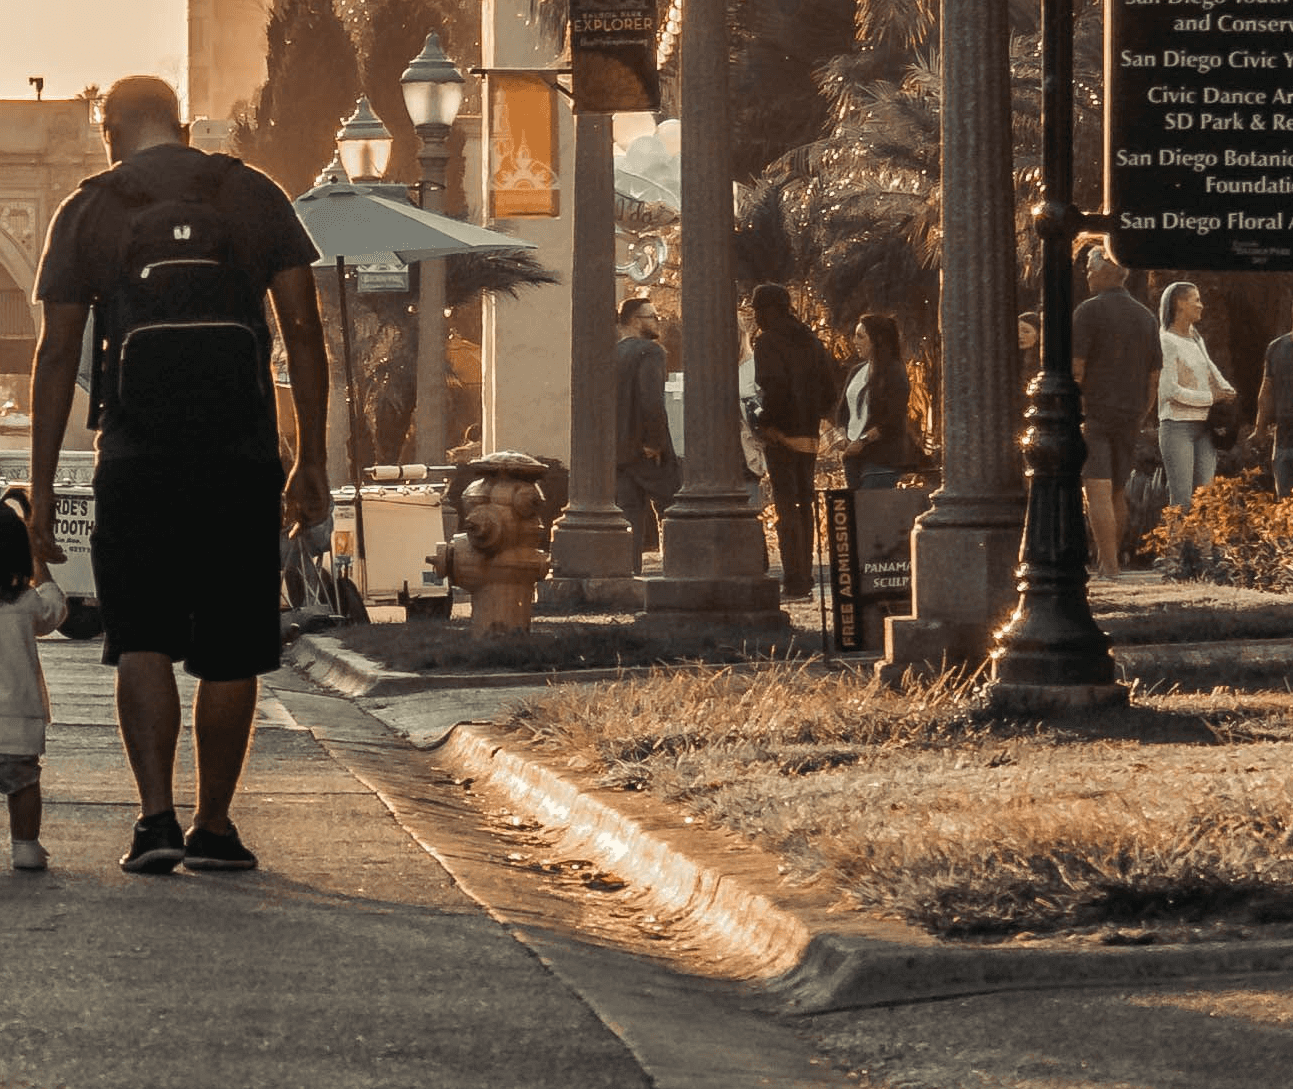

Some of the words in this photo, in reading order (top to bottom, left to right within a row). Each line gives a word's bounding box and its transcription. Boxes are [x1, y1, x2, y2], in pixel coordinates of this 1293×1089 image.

[574, 17, 653, 32] EXPLORER
[1173, 13, 1211, 31] and
[1121, 49, 1156, 67] San
[1163, 49, 1222, 74] Diego
[1228, 50, 1278, 69] Civic
[1147, 85, 1197, 104] Civic
[1203, 87, 1267, 104] Dance
[1165, 112, 1193, 130] SD
[1200, 112, 1244, 130] Park
[1249, 114, 1266, 131] &
[1116, 149, 1152, 167] San
[1159, 148, 1218, 172] Diego
[1206, 175, 1293, 193] Foundati
[1120, 212, 1156, 229] San
[1162, 211, 1221, 235] Diego
[1227, 211, 1283, 230] Floral
[833, 499, 853, 597] ADMISSION
[841, 603, 856, 646] FREE
